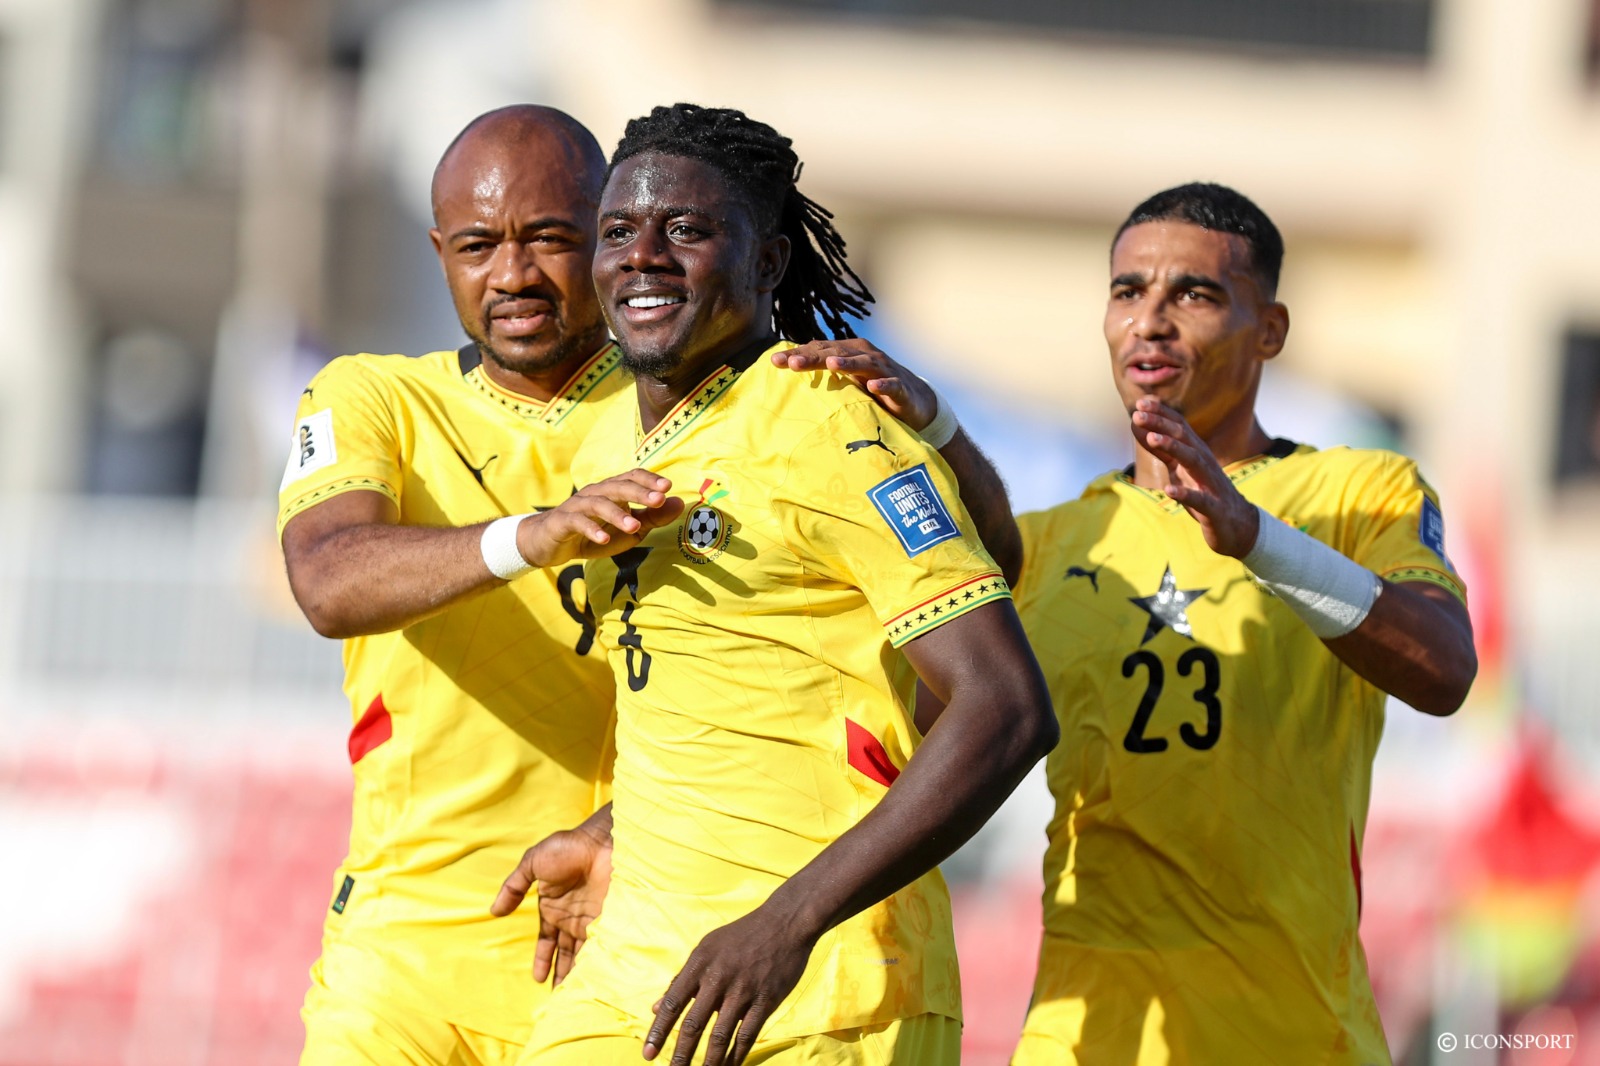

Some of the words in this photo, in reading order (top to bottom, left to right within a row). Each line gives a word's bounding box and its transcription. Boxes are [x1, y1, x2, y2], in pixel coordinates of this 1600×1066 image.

[888, 482, 922, 503] FOOTBALL
[894, 491, 929, 515] UNITES
[901, 514, 918, 528] the
[915, 504, 938, 520] World
[706, 524, 733, 563] ASSOCIATION
[557, 564, 597, 656] 9
[1121, 647, 1222, 753] 23
